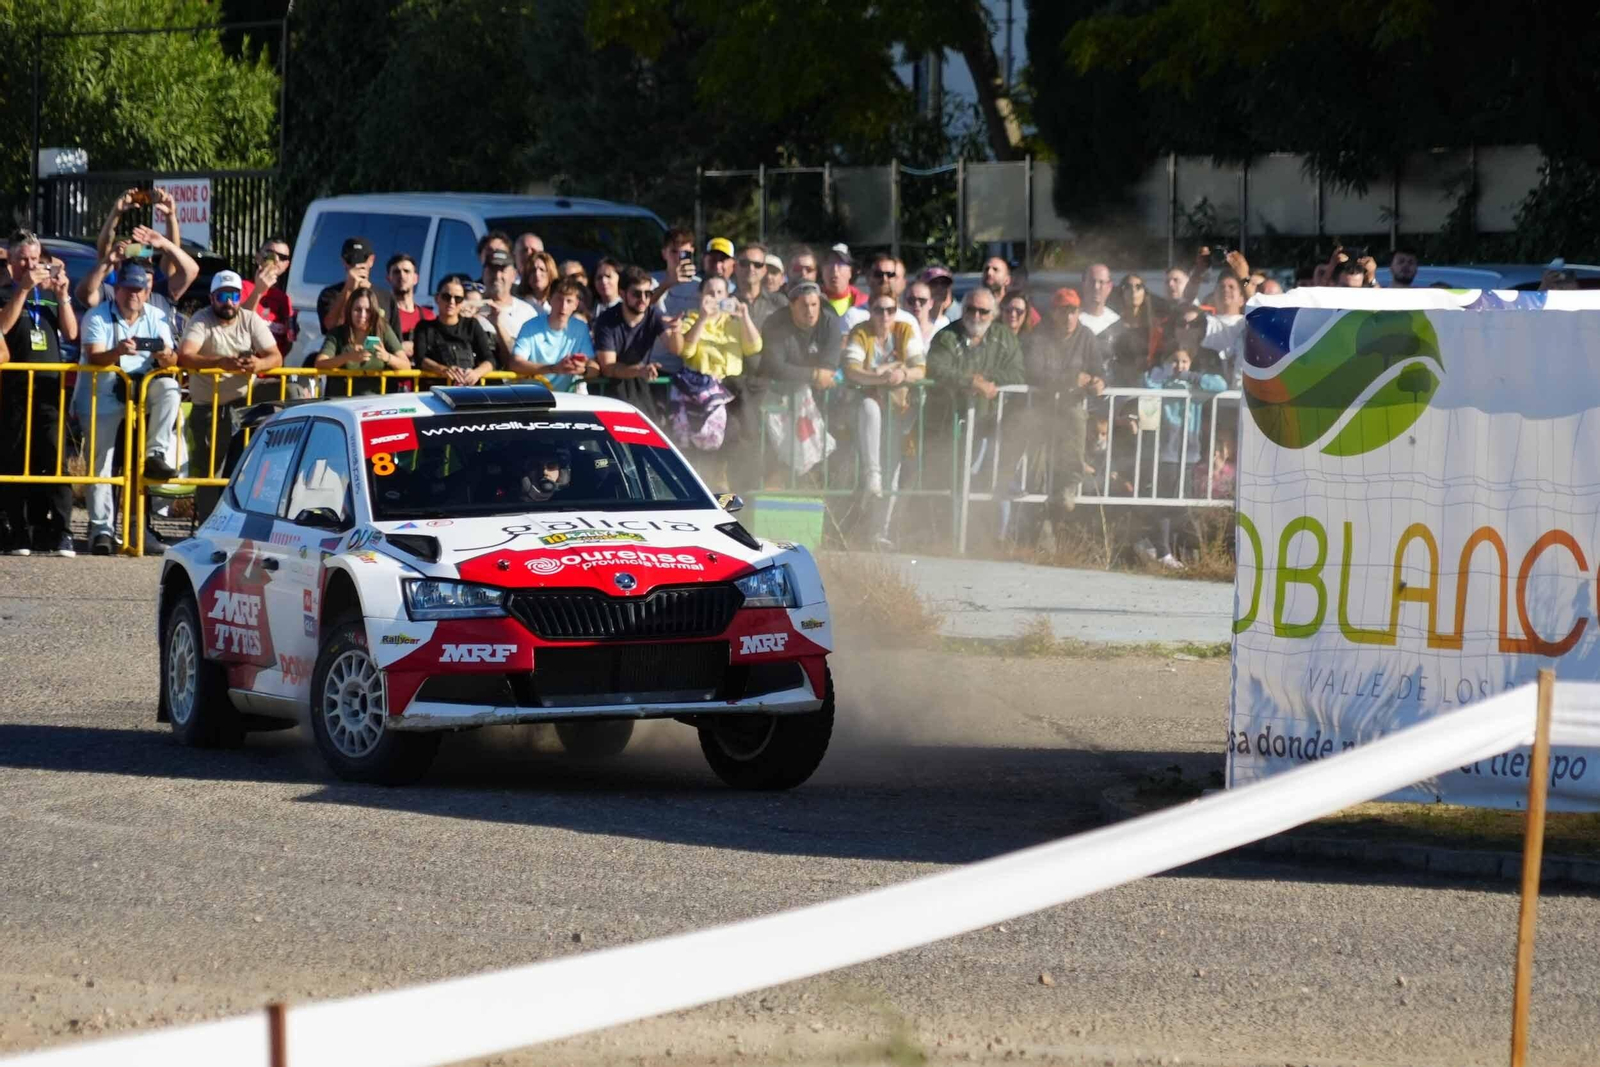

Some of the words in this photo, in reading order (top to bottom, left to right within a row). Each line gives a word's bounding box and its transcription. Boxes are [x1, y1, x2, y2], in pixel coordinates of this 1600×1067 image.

[201, 185, 209, 202] O
[175, 206, 208, 223] QUILA
[422, 421, 605, 436] www.rallycar.es
[371, 452, 395, 476] 8
[470, 516, 700, 545] galicia
[542, 533, 569, 546] 10
[560, 550, 697, 567] ourense
[1232, 510, 1600, 658] BLANC
[207, 589, 261, 626] MRF
[214, 623, 262, 656] TYRES
[380, 633, 421, 646] Rallycar
[740, 633, 788, 655] MRF
[439, 644, 517, 662] MRF
[1309, 668, 1384, 699] VALLE
[1397, 674, 1429, 702] DE
[1443, 678, 1488, 704] LOS
[1257, 724, 1334, 761] donde
[1491, 752, 1587, 787] tiepo
